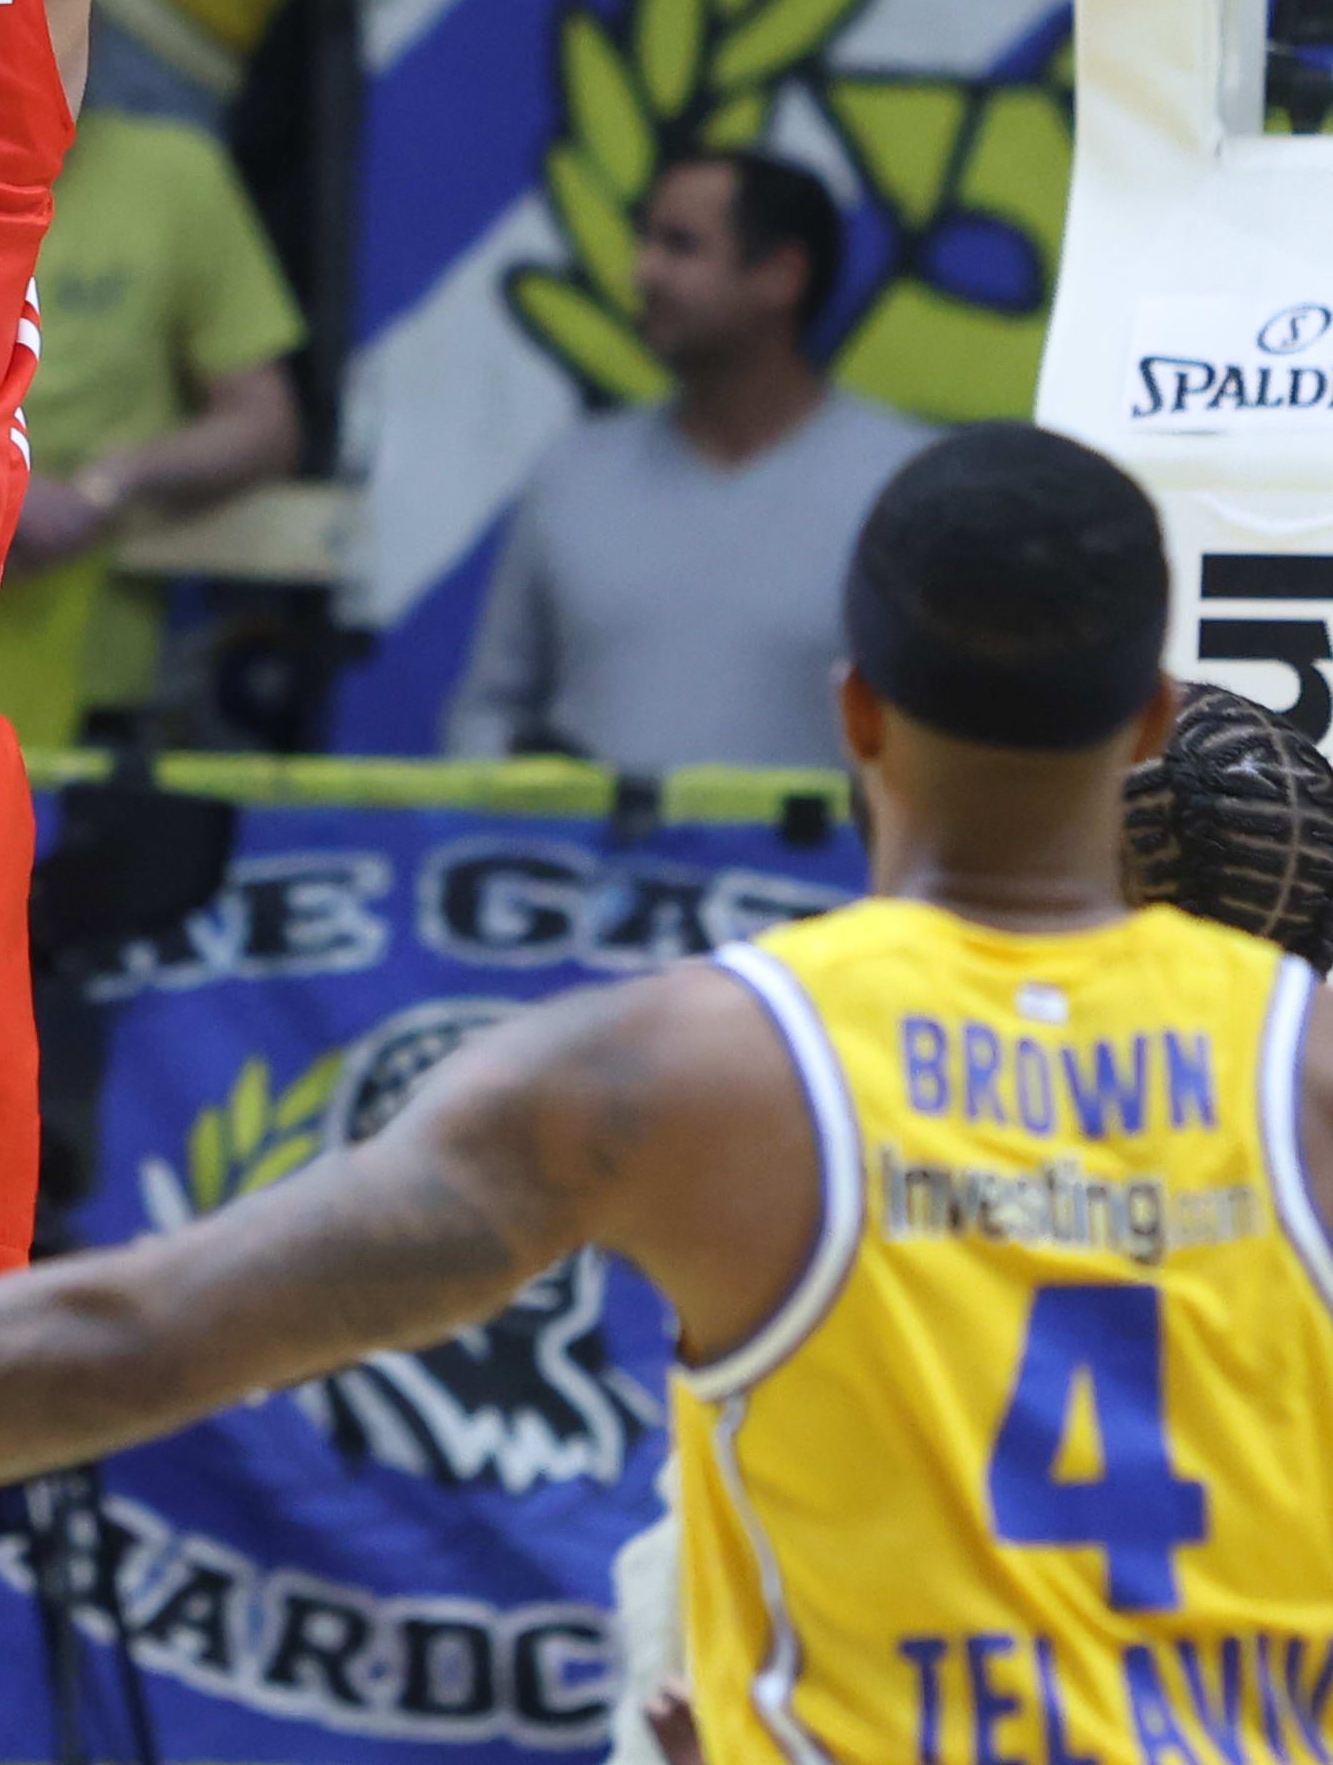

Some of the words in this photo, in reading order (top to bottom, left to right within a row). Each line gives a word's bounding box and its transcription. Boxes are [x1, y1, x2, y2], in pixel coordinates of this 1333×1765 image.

[1132, 356, 1333, 418] SPALD
[901, 1015, 1217, 1138] BROWN
[987, 1283, 1208, 1614] 4
[897, 1631, 1101, 1765] TEL
